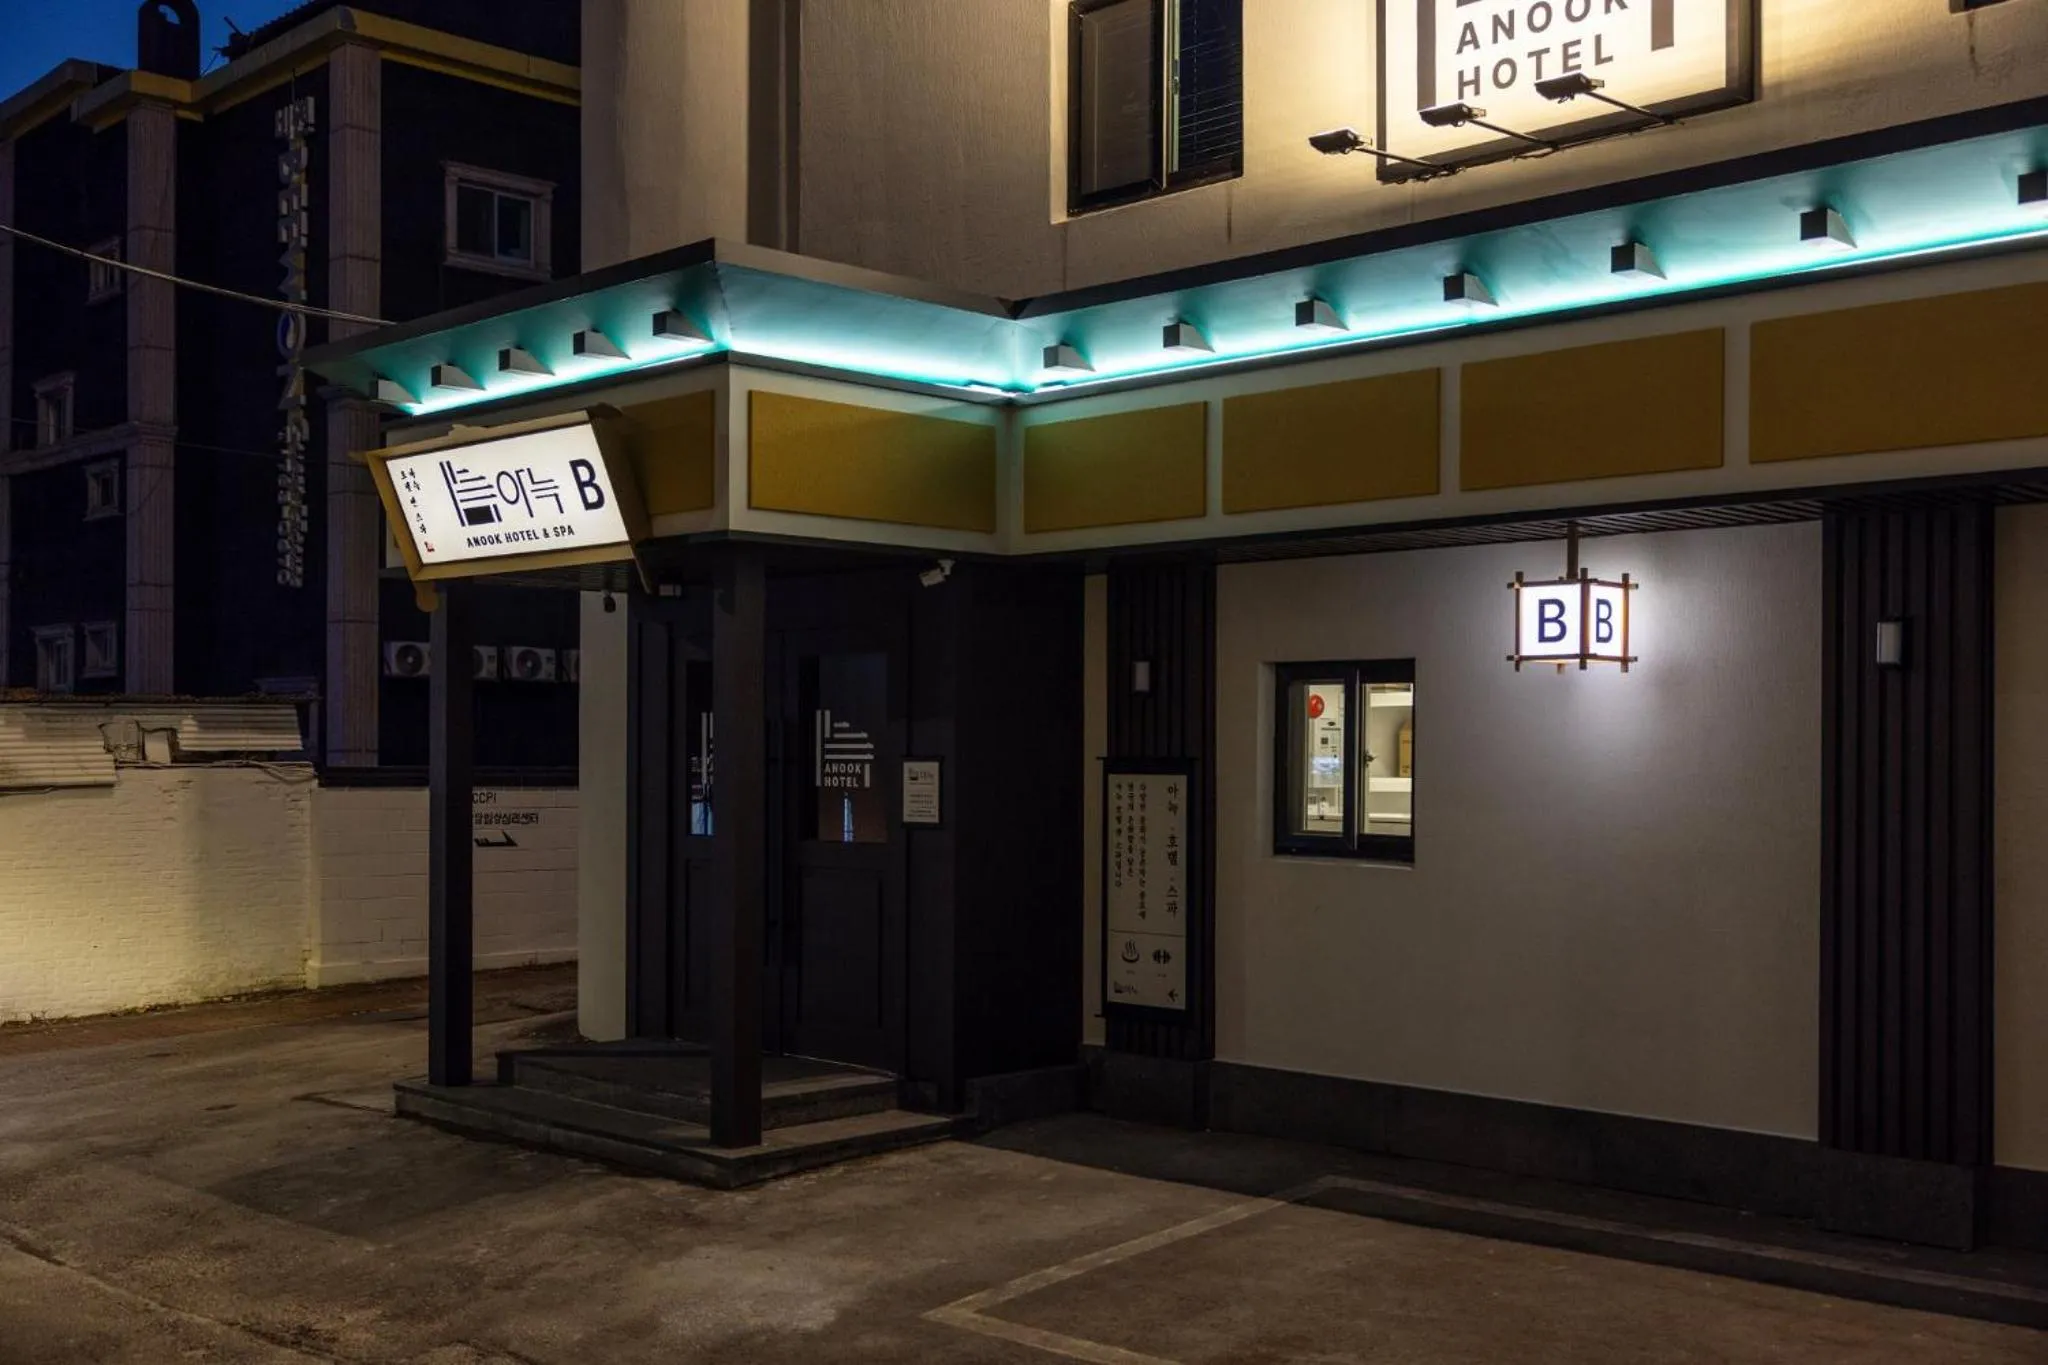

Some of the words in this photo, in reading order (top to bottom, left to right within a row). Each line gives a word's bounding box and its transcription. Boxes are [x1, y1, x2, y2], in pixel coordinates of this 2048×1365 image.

[1457, 33, 1614, 101] HOTEL
[569, 458, 606, 512] B
[466, 533, 503, 549] ANOOK
[504, 528, 541, 544] HOTEL
[543, 527, 551, 539] &
[552, 523, 576, 538] SPA
[1537, 598, 1568, 644] B
[1595, 598, 1614, 644] B
[823, 775, 860, 788] HOTEL
[824, 762, 861, 775] ANOOK
[1166, 834, 1179, 867] 호텔
[1166, 885, 1179, 921] 스파
